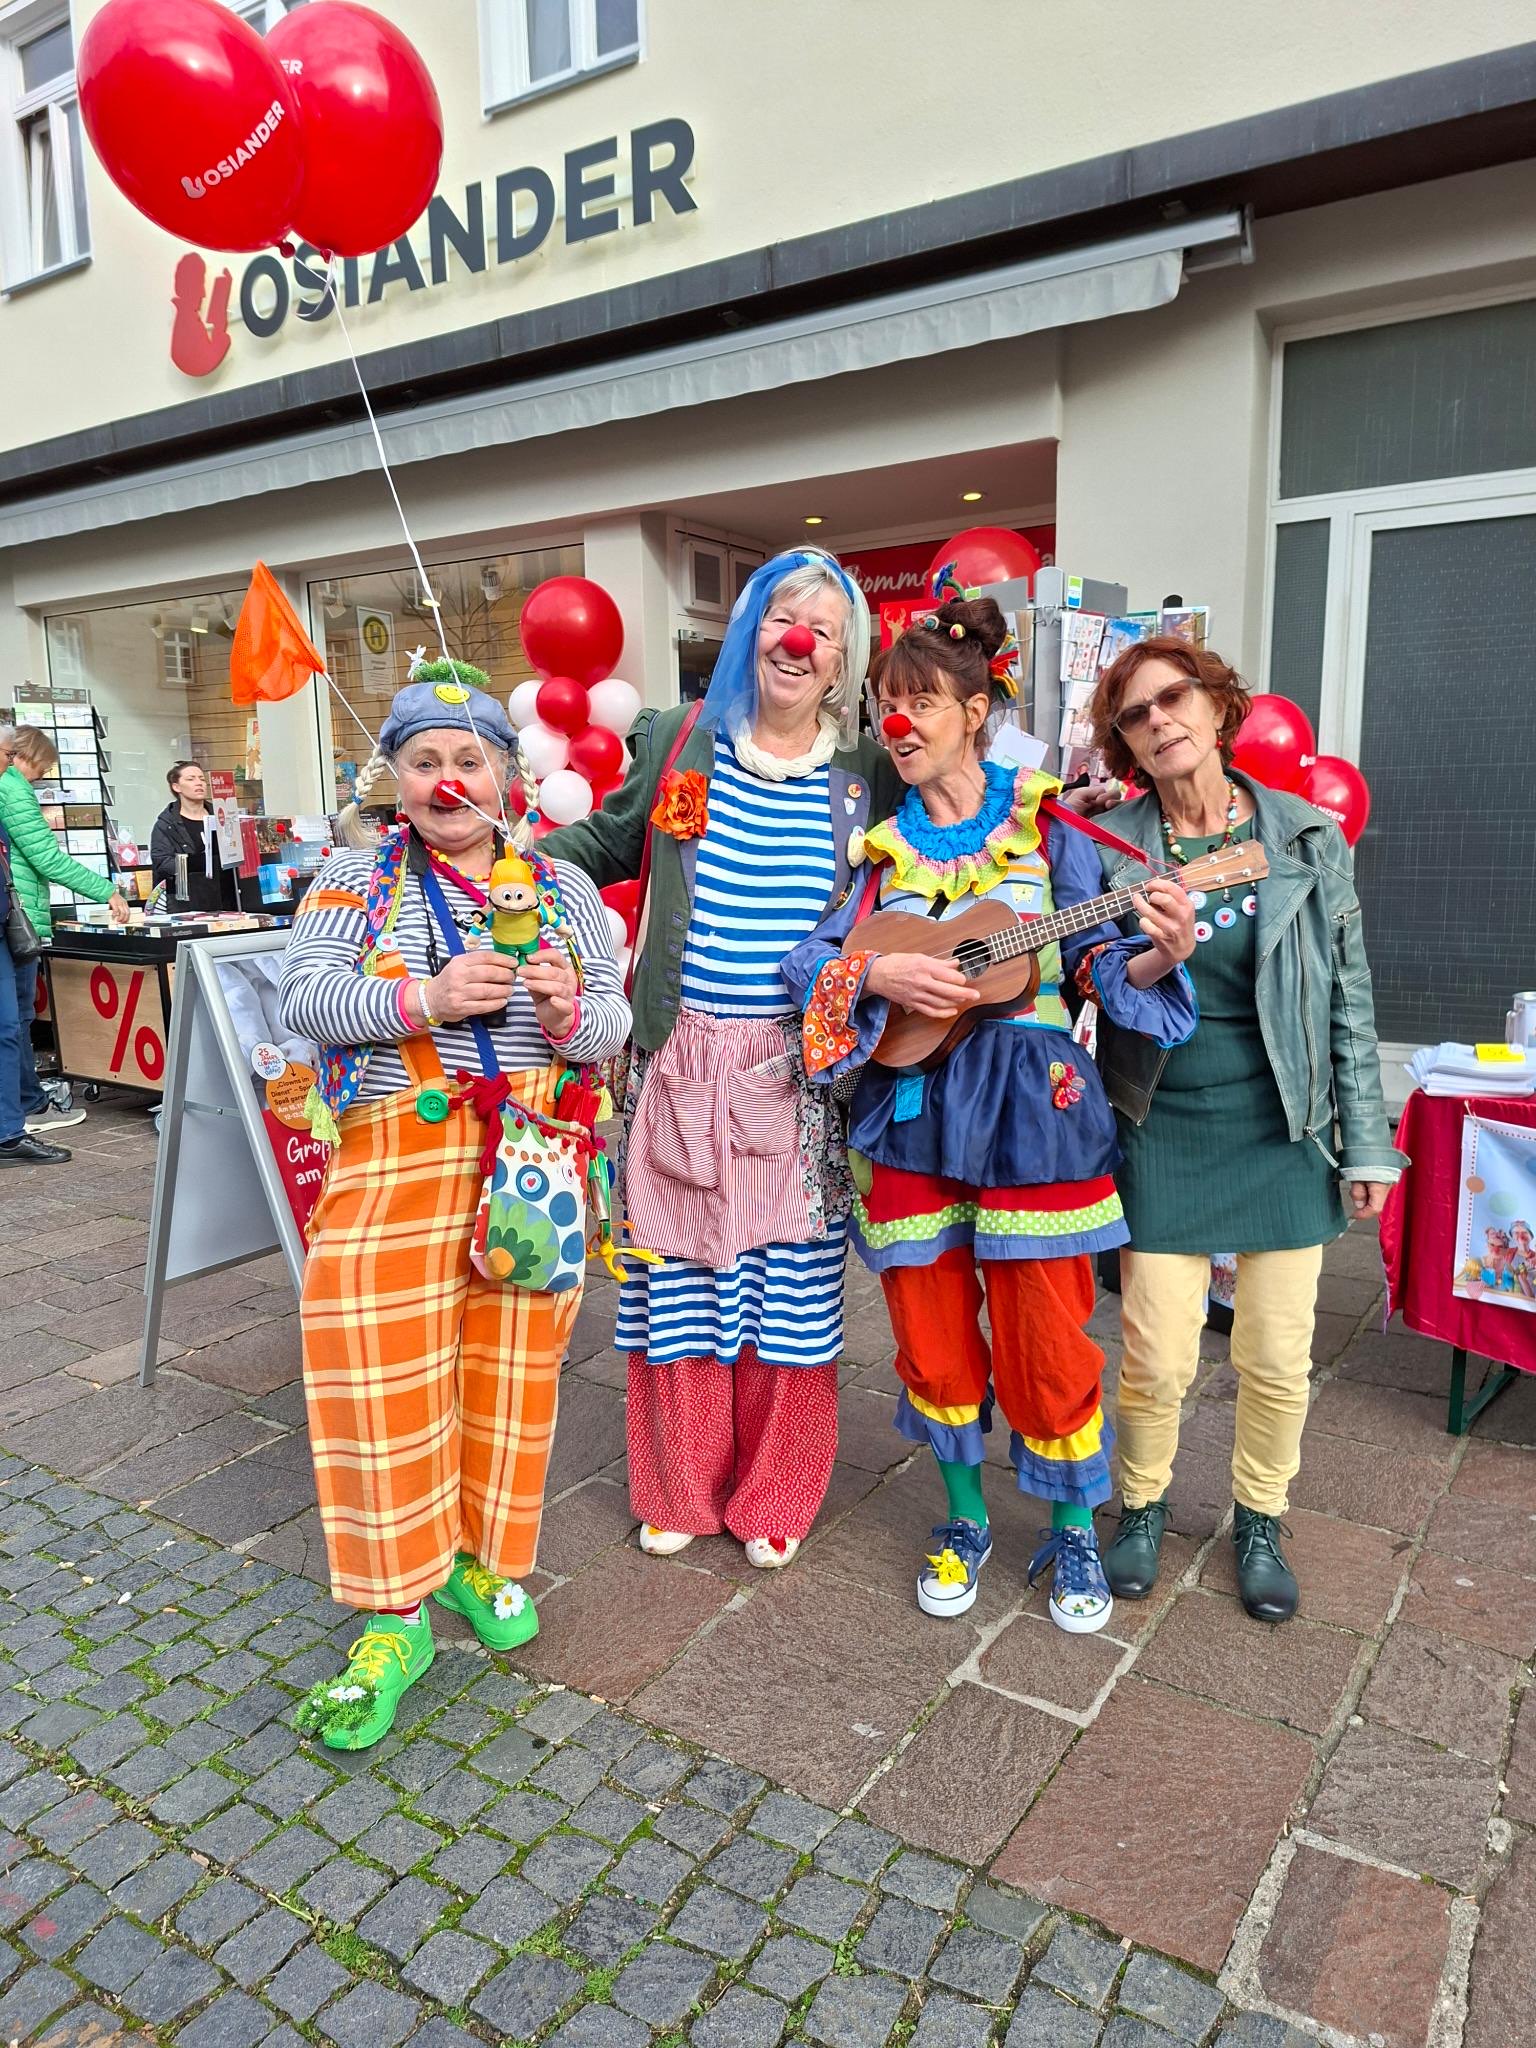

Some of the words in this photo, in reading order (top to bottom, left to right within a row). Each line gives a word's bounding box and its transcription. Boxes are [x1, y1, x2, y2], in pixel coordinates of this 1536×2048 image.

[203, 100, 285, 186] OSIANDER
[240, 117, 698, 338] OSIANDER
[257, 1047, 269, 1056] 25
[295, 1168, 322, 1185] am
